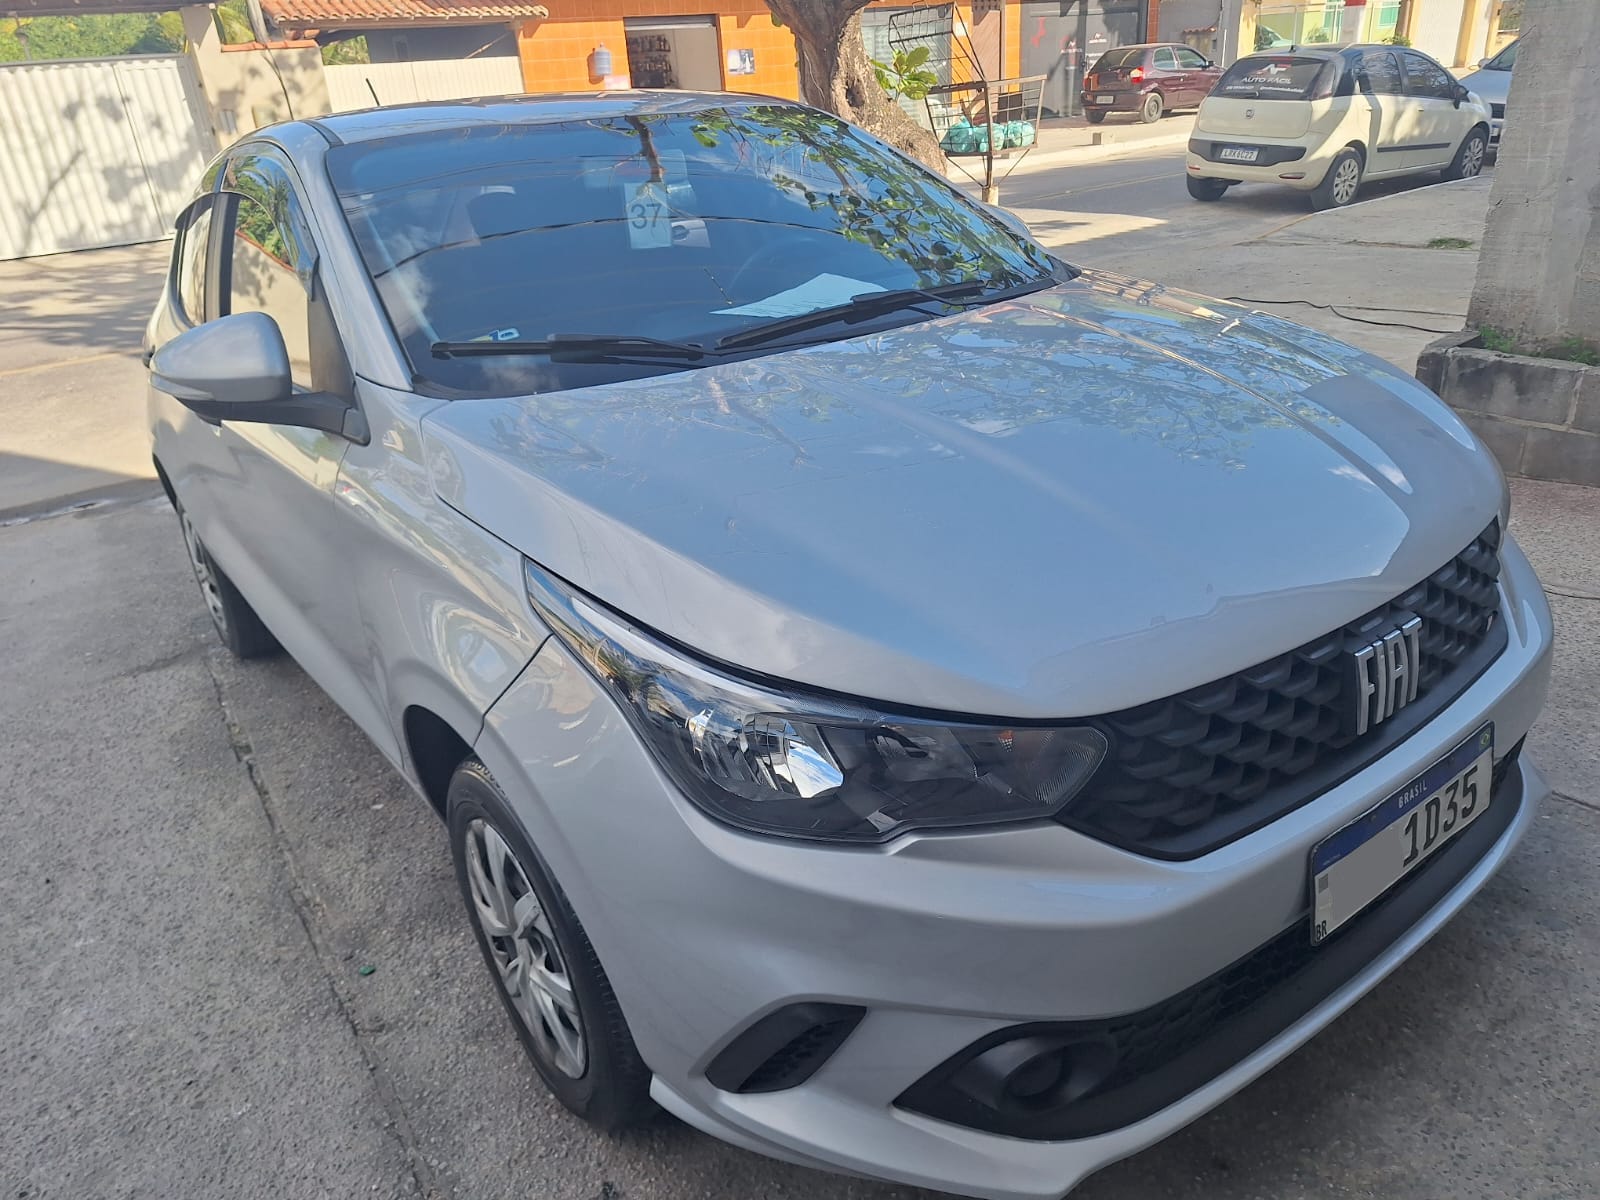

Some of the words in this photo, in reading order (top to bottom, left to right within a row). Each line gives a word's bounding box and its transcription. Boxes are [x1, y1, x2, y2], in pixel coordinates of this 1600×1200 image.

[631, 203, 662, 230] 37
[1354, 616, 1423, 736] FIAT
[1398, 778, 1428, 809] BRASIL
[1402, 765, 1479, 868] 1D35
[1315, 919, 1328, 940] BR
